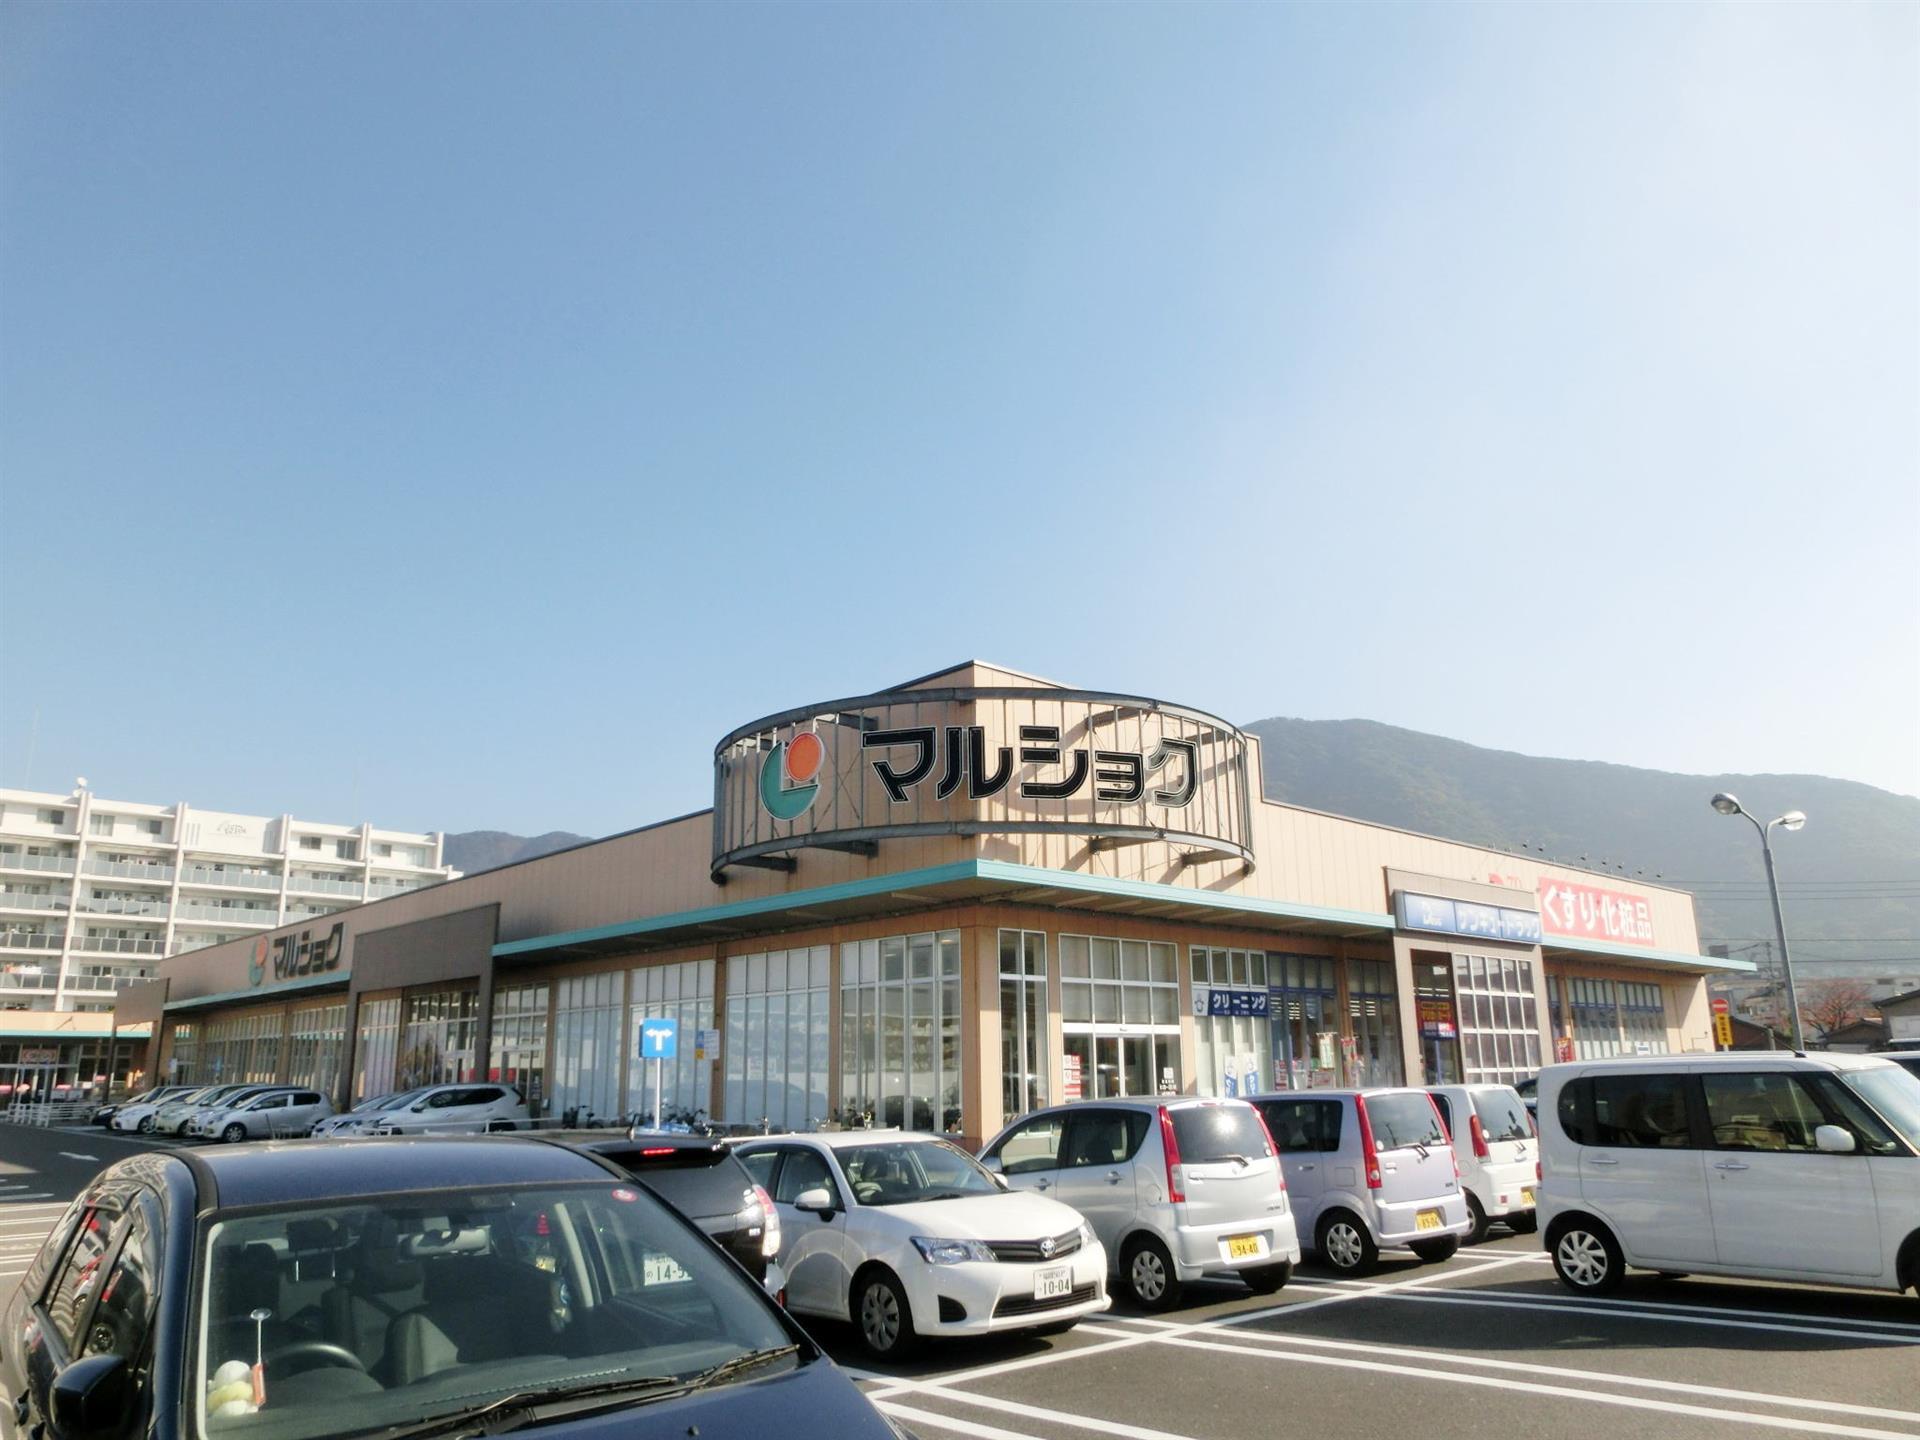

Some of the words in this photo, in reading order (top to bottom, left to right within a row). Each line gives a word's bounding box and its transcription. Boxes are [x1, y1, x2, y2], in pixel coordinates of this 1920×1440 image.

[861, 725, 1198, 808] マルショク
[273, 922, 344, 979] マルショク
[1213, 993, 1266, 1010] クリーニング
[1043, 1278, 1070, 1296] 10-04
